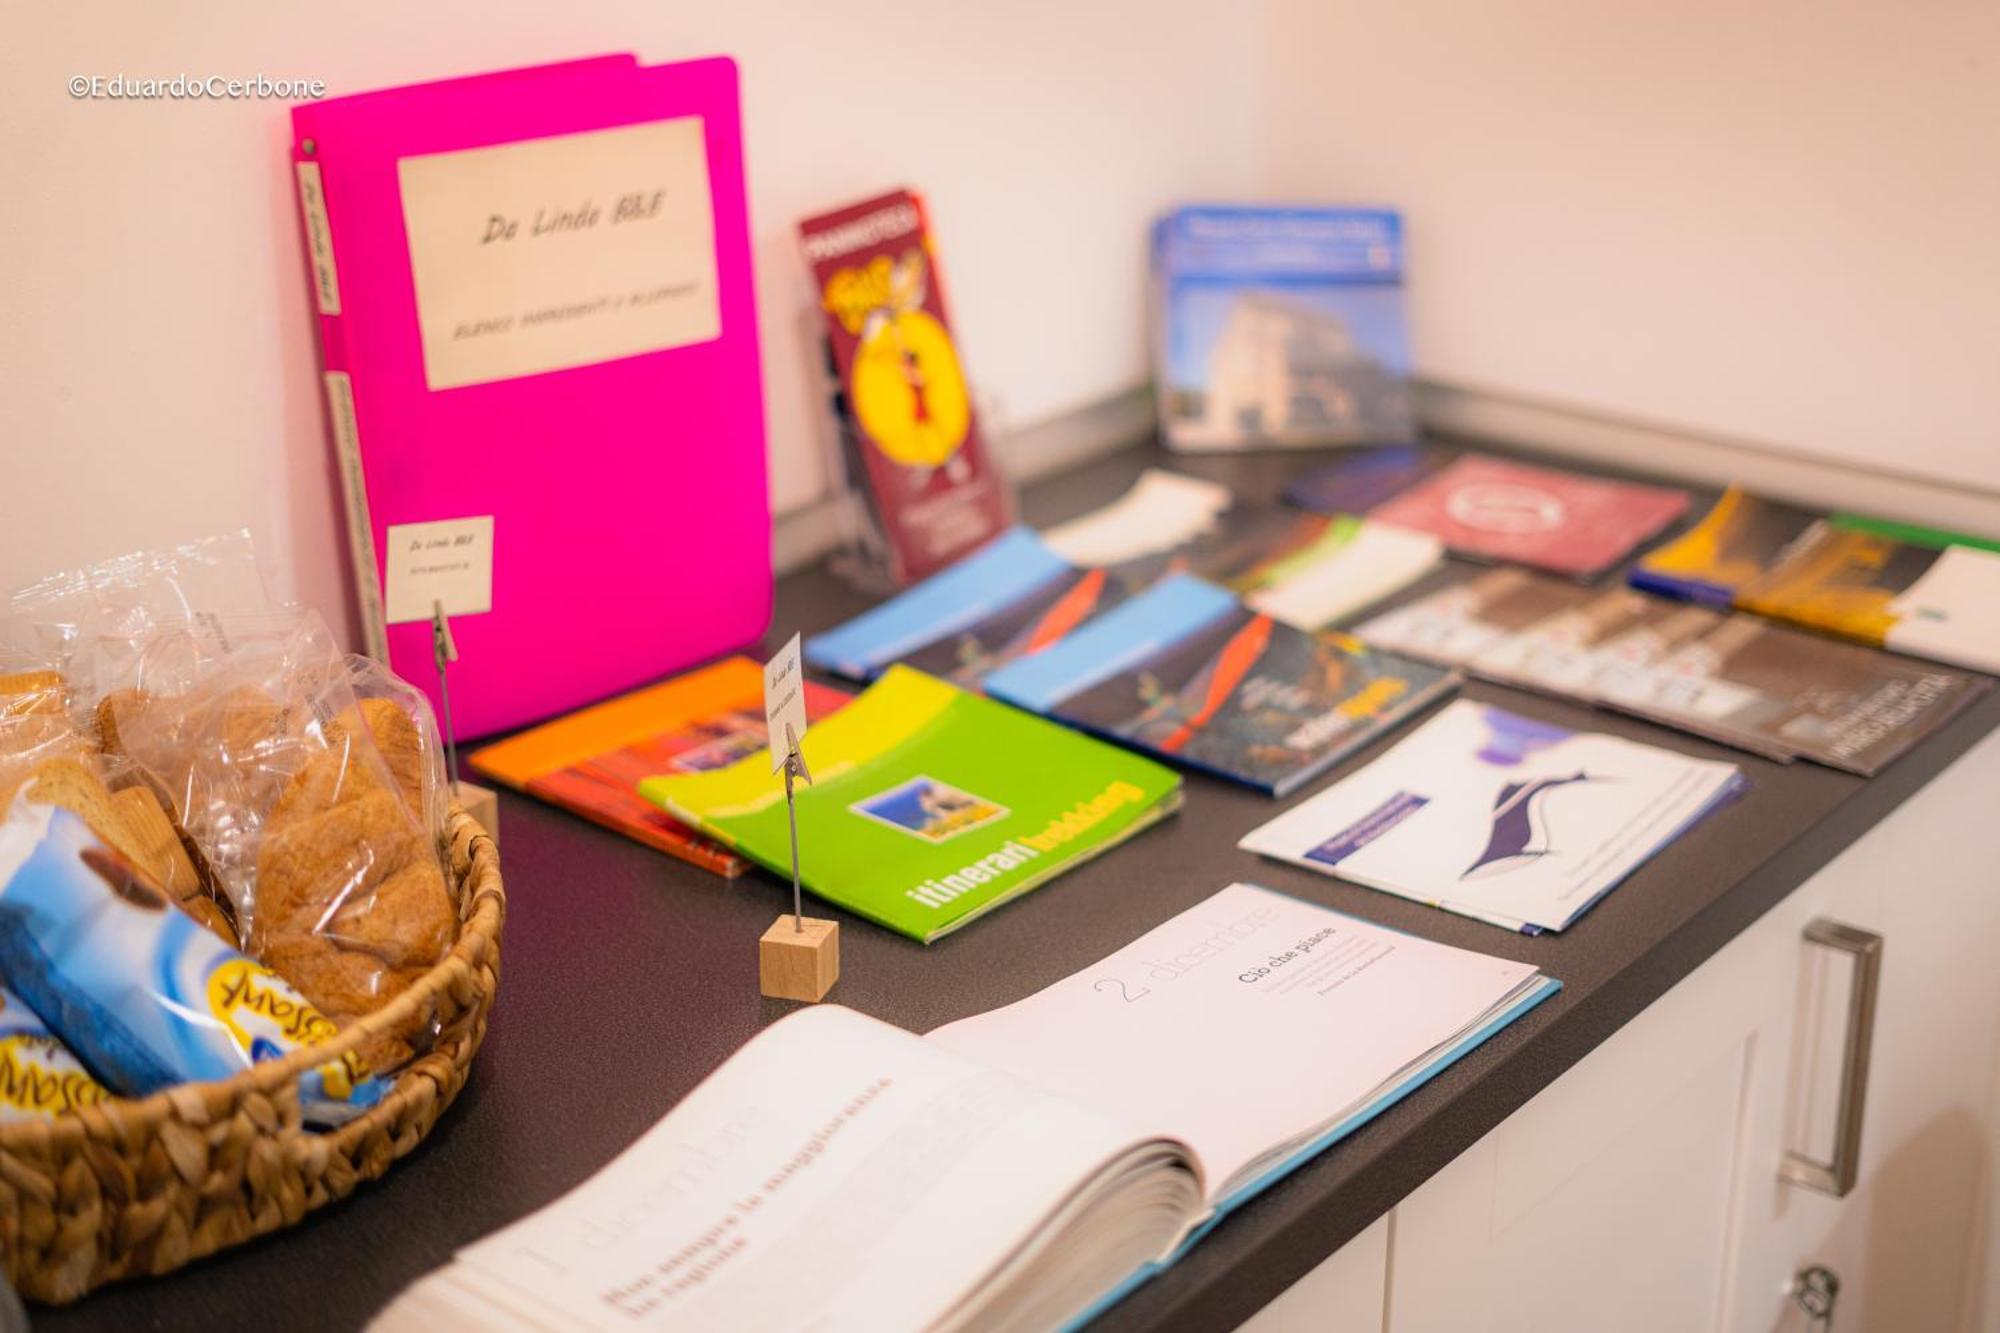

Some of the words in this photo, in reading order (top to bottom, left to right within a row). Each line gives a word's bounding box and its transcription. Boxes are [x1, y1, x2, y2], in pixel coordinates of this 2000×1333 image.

[905, 840, 1040, 909] itinerari
[1268, 948, 1299, 968] che
[1296, 927, 1337, 954] piace
[1093, 977, 1152, 1003] 2
